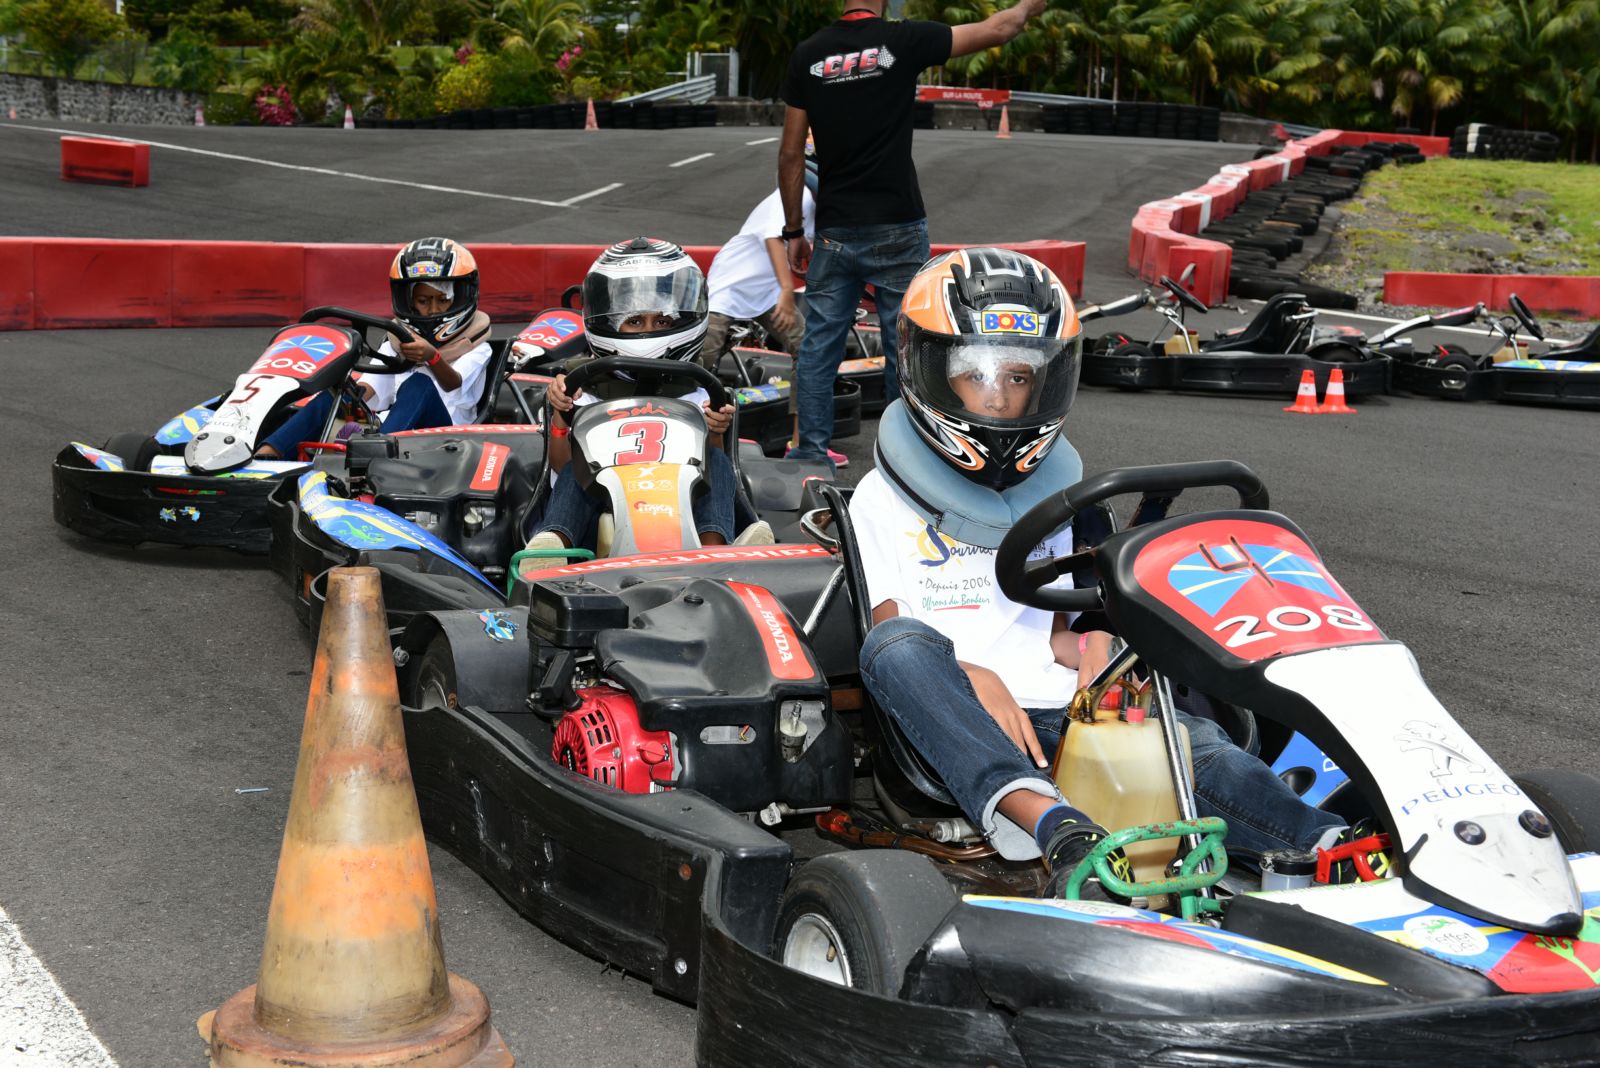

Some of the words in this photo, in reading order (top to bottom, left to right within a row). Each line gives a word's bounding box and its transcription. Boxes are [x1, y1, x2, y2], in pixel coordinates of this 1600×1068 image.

[249, 358, 317, 374] 208
[613, 421, 668, 465] 3
[481, 455, 498, 482] HONDA
[558, 547, 829, 574] odikart.com
[925, 577, 959, 593] Depuis
[963, 575, 991, 590] 2006
[760, 610, 794, 665] HONDA
[1214, 605, 1374, 647] 208
[1401, 783, 1522, 815] PEUGEO
